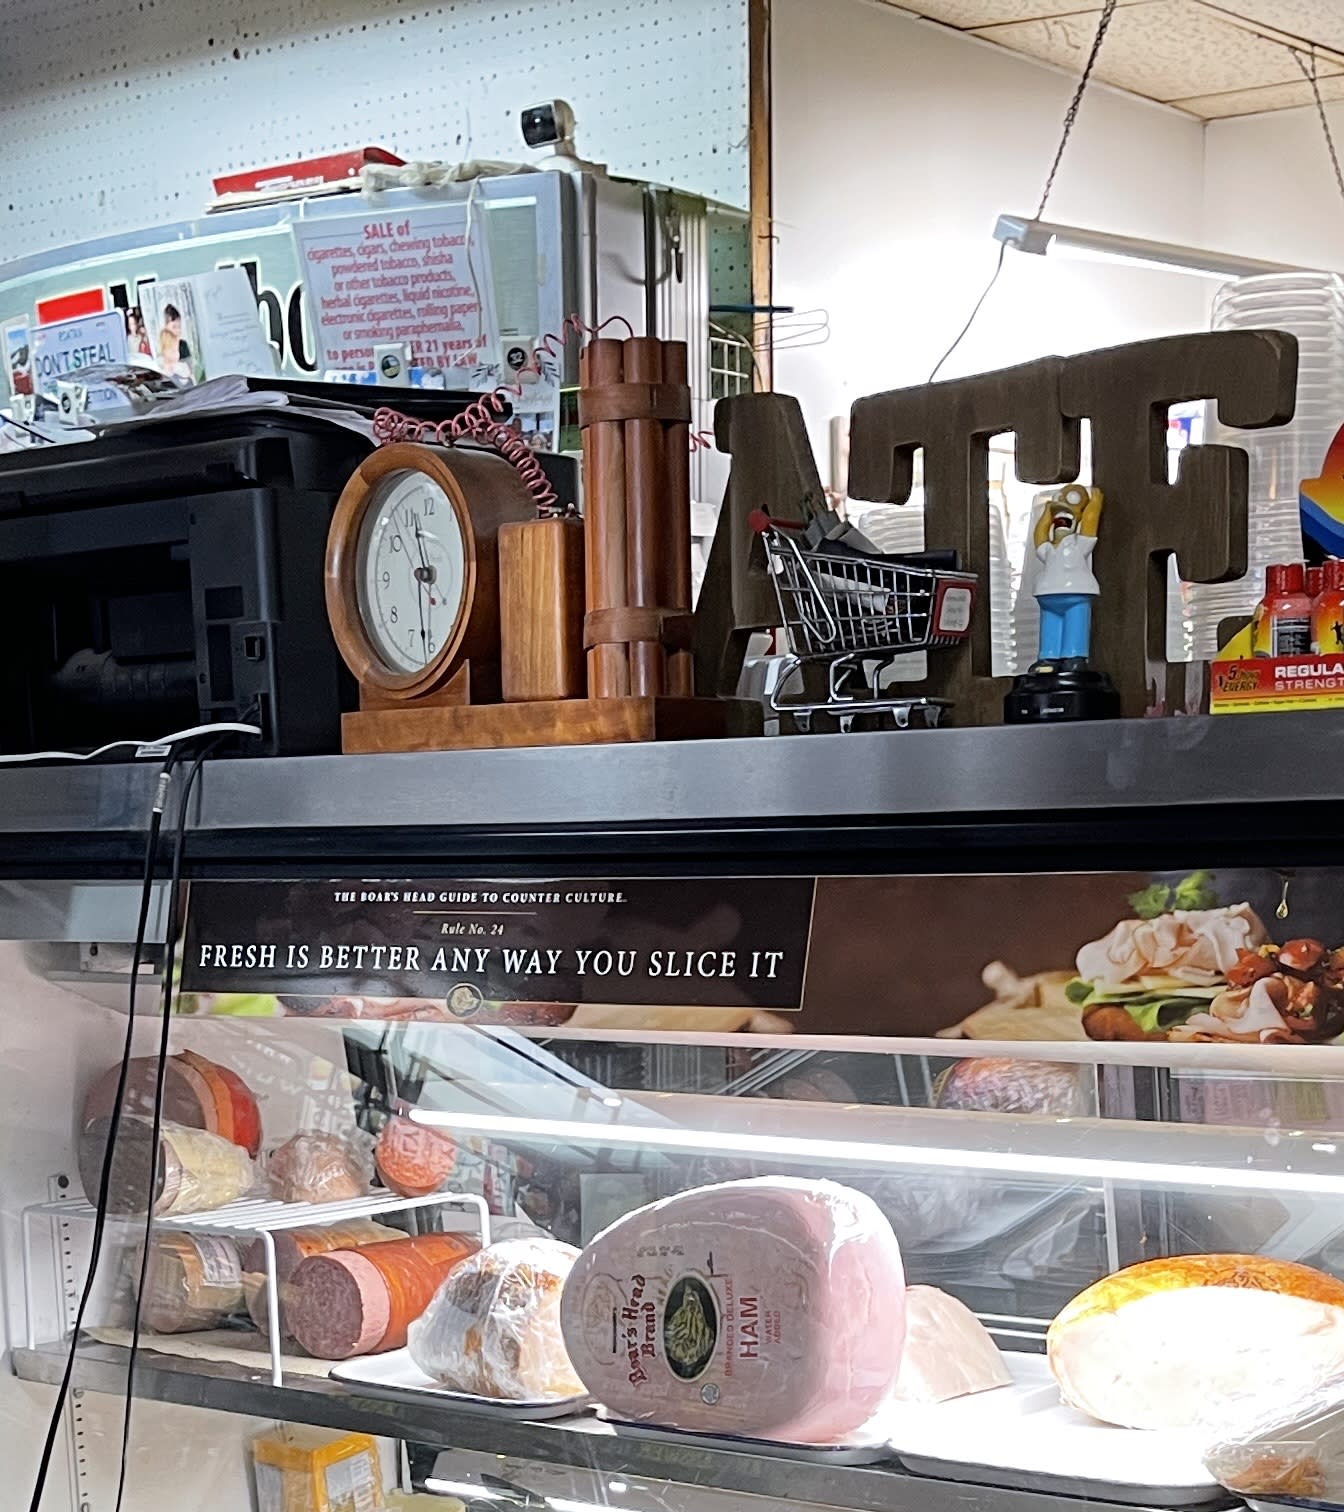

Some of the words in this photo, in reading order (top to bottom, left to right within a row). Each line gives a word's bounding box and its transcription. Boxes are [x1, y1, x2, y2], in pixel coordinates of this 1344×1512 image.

[364, 223, 393, 240] SALE
[396, 220, 410, 235] of
[36, 346, 70, 378] DON'T
[73, 342, 115, 368] STEAL
[327, 350, 340, 361] to
[425, 339, 438, 353] 21
[442, 337, 473, 353] years
[334, 891, 356, 902] THE
[360, 891, 399, 902] BOAR'S
[403, 892, 436, 902] HEAD
[439, 892, 478, 903] GUIDE
[481, 893, 498, 903] TO
[503, 892, 561, 904] COUNTER
[441, 923, 466, 935] Rule
[468, 923, 487, 936] No.
[490, 924, 504, 936] 24
[199, 943, 277, 969] FRESH
[286, 944, 310, 970] IS
[319, 944, 421, 972] BETTER
[431, 946, 490, 974] ANY
[502, 948, 561, 976] WAY
[576, 949, 636, 978] YOU
[648, 950, 738, 979] SLICE
[749, 950, 785, 979] IT
[623, 1274, 646, 1320] Head
[726, 1278, 735, 1322] DELUXE
[639, 1302, 657, 1359] Brand
[739, 1296, 759, 1359] HAM
[620, 1324, 649, 1387] Boar's
